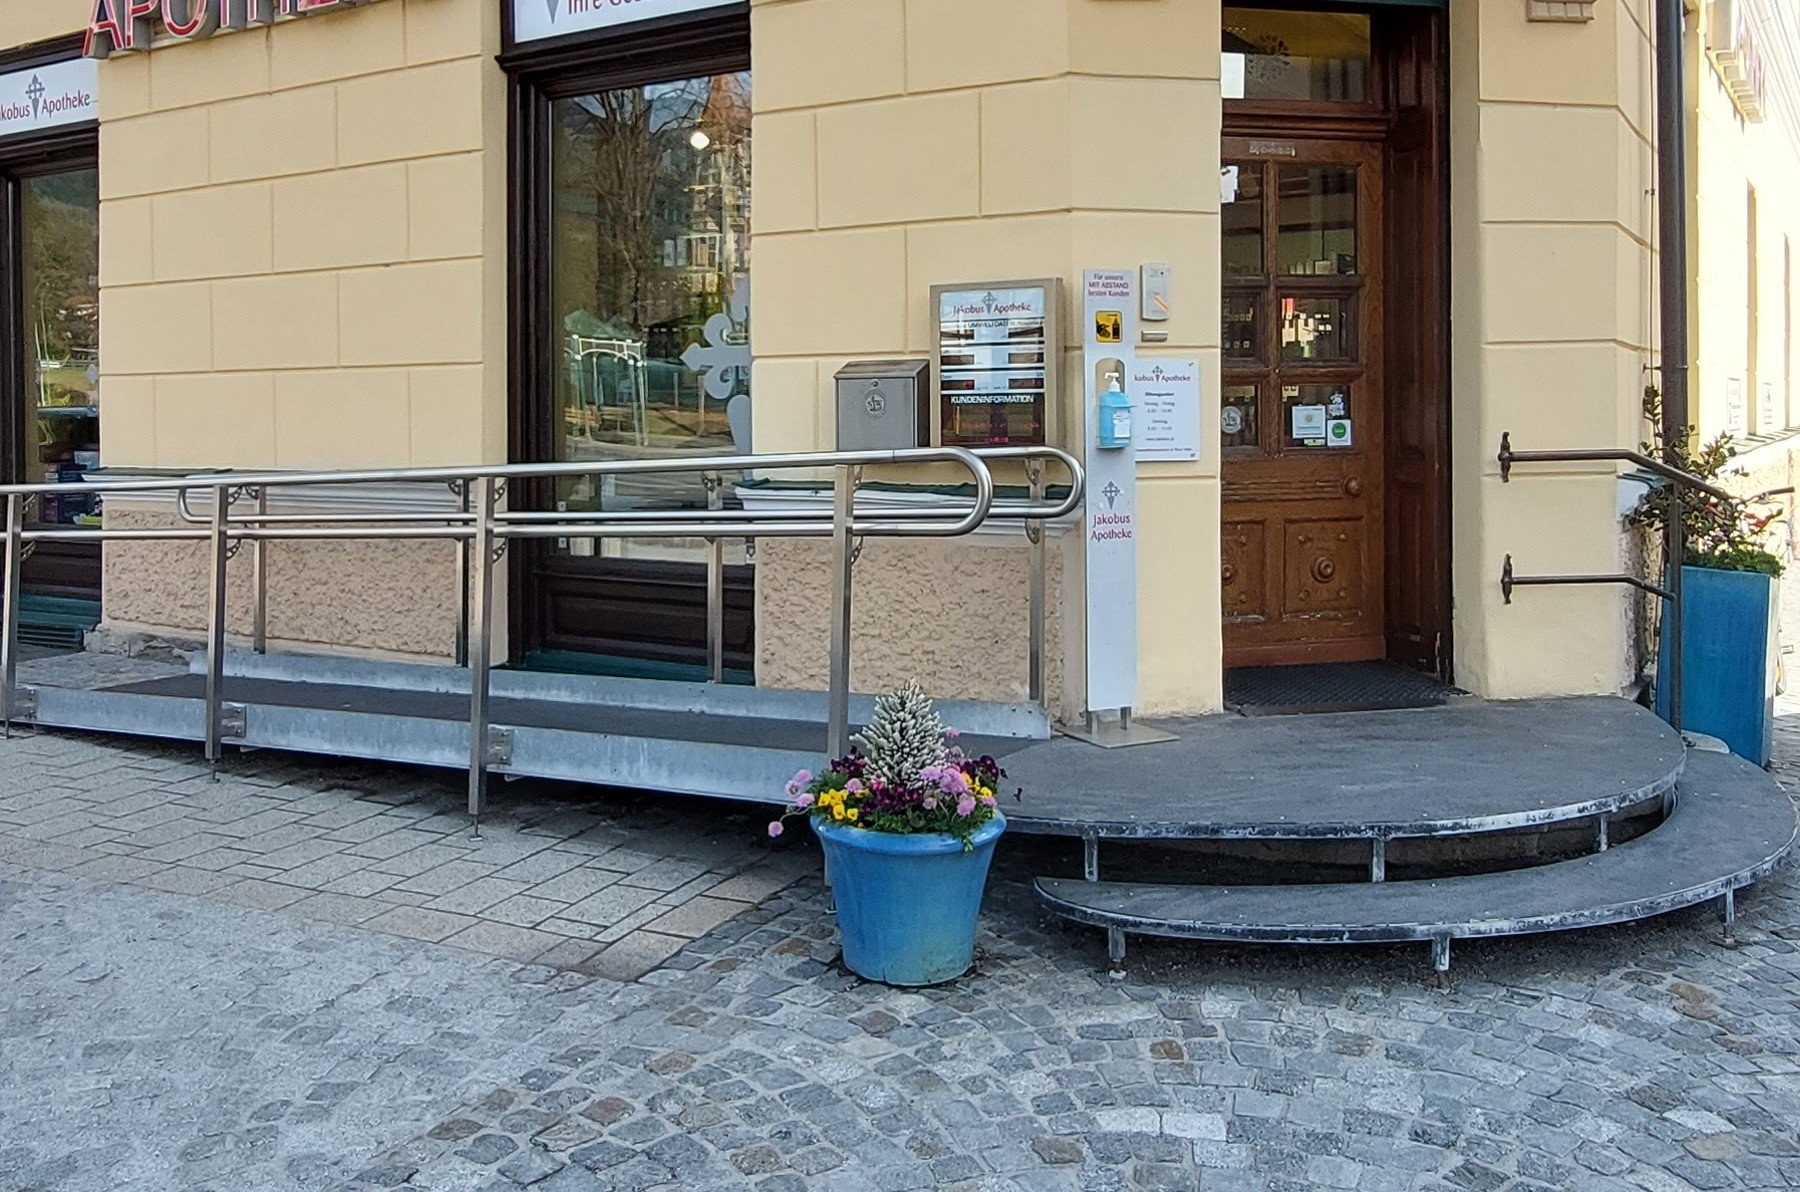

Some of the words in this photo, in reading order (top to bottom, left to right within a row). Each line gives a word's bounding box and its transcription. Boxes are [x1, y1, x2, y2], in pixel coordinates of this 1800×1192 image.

[0, 102, 31, 121] kobus
[41, 89, 91, 118] Apotheke
[1108, 289, 1130, 297] Kunden
[952, 304, 985, 317] Jakobus
[993, 302, 1032, 315] Apotheke
[1134, 374, 1154, 382] kobus
[1160, 374, 1191, 383] Apotheke
[950, 394, 1034, 404] KUNDENINFORMATION
[1092, 513, 1131, 528] Jakobus
[1090, 528, 1133, 543] Apotheke
